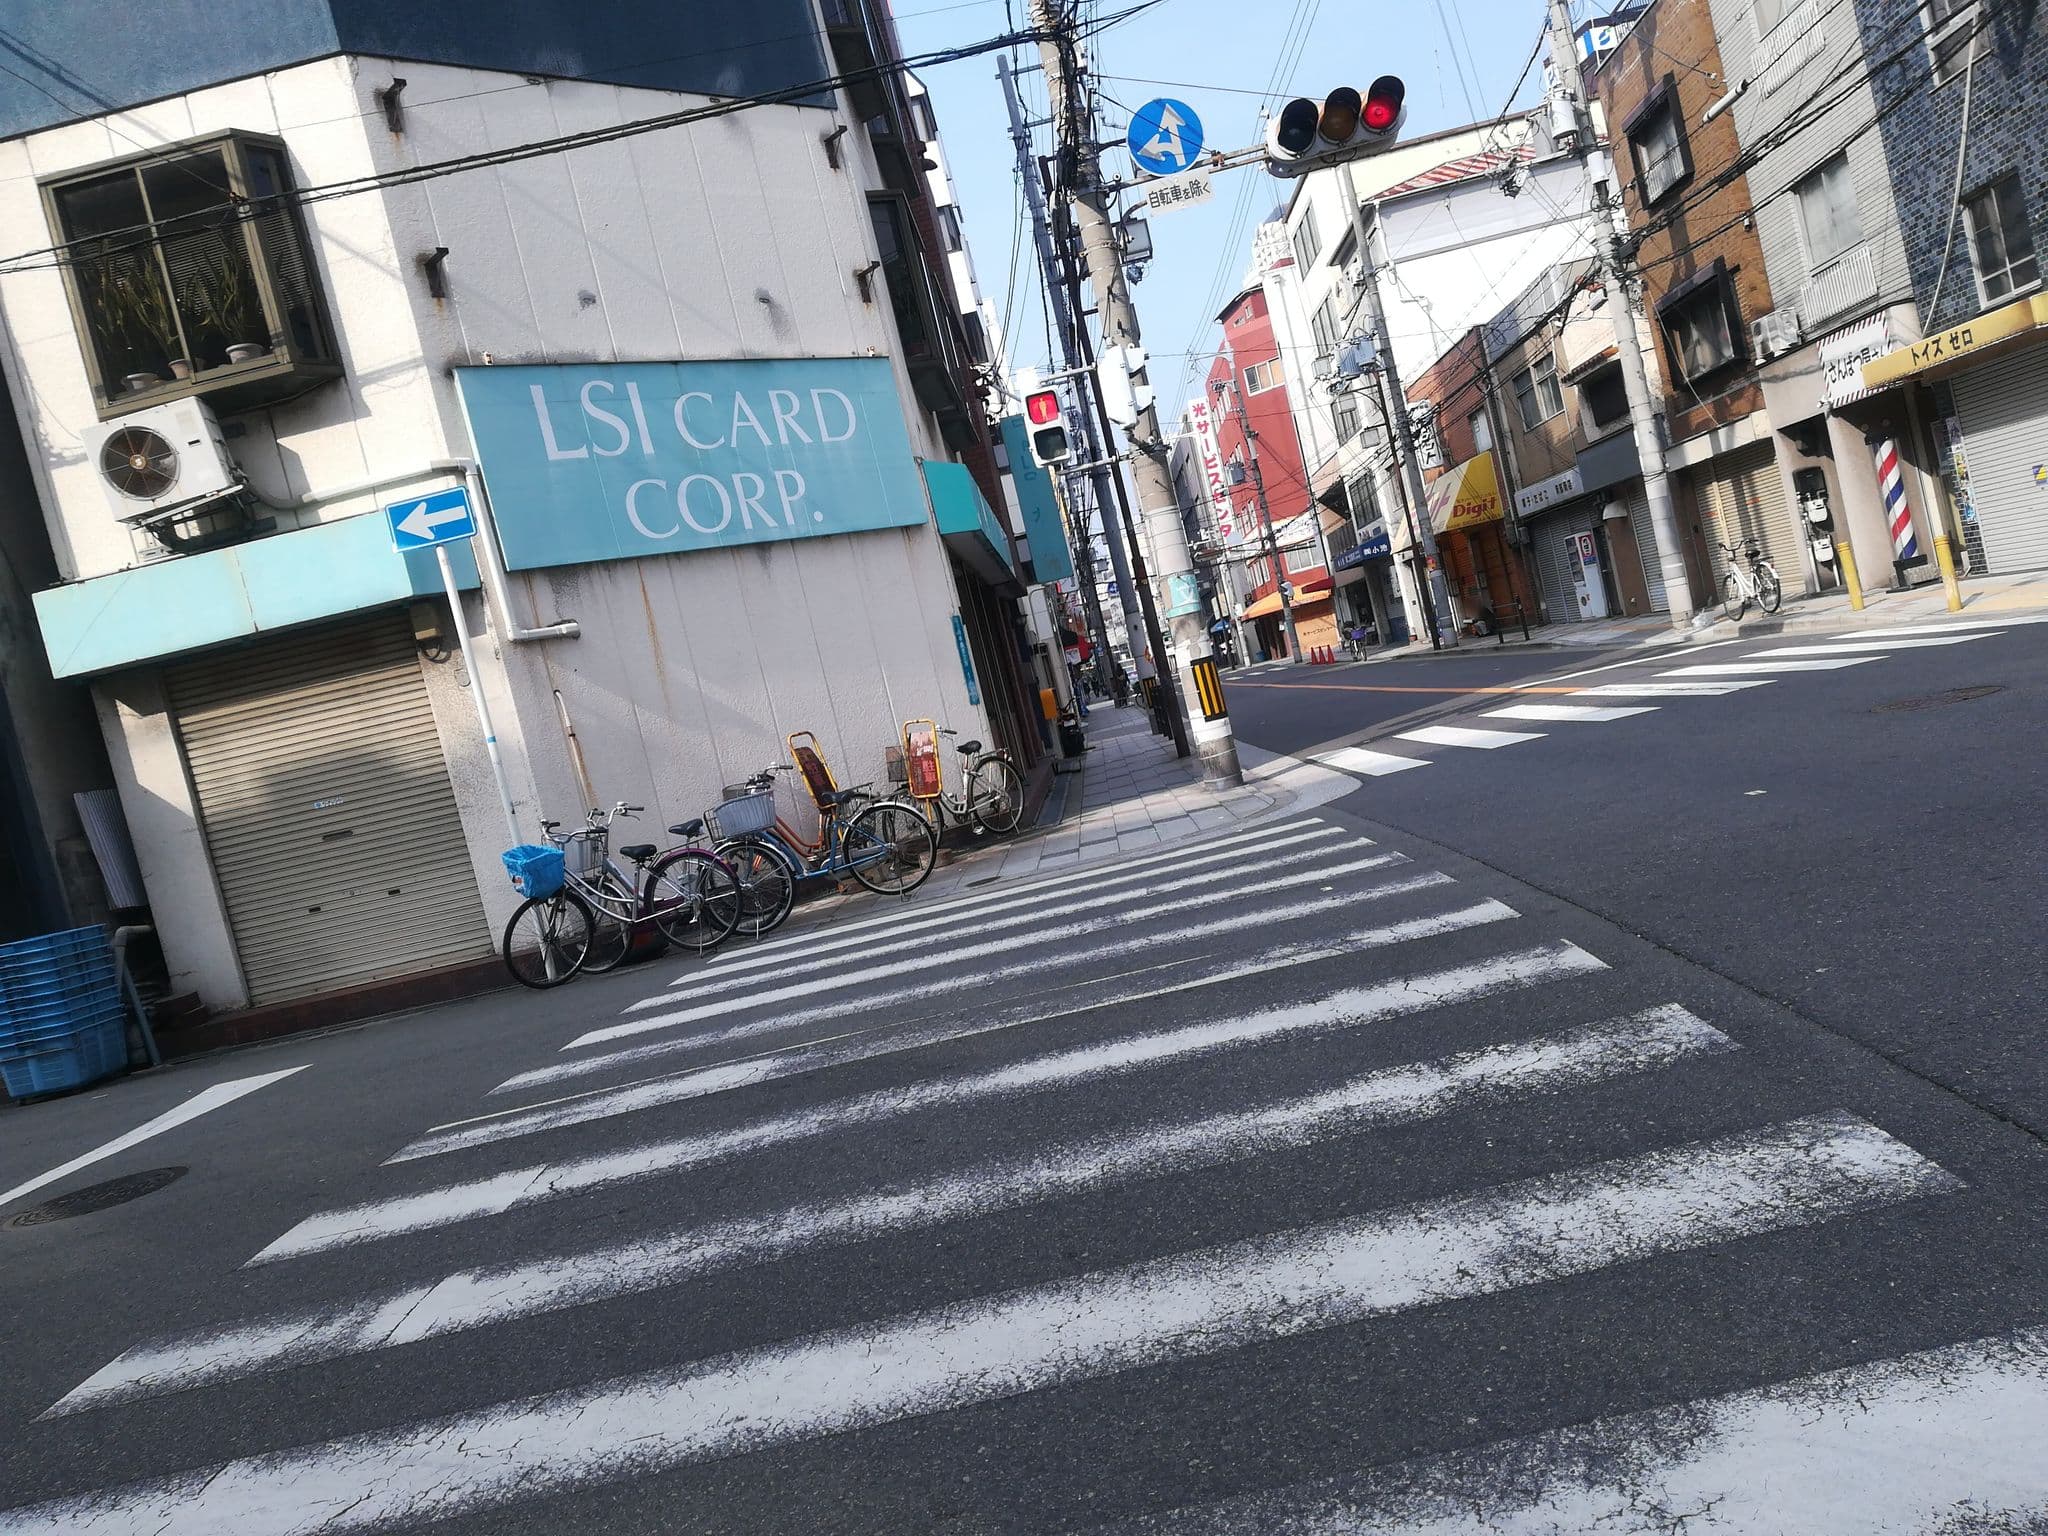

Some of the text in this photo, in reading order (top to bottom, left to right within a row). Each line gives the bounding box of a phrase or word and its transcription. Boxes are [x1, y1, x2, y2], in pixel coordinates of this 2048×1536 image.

[1148, 180, 1211, 209] 自転車を除く
[1911, 328, 1974, 366] トイズ ゼロ
[528, 379, 857, 461] LSI CARD
[625, 470, 824, 540] CORP.
[1452, 496, 1497, 519] Digit
